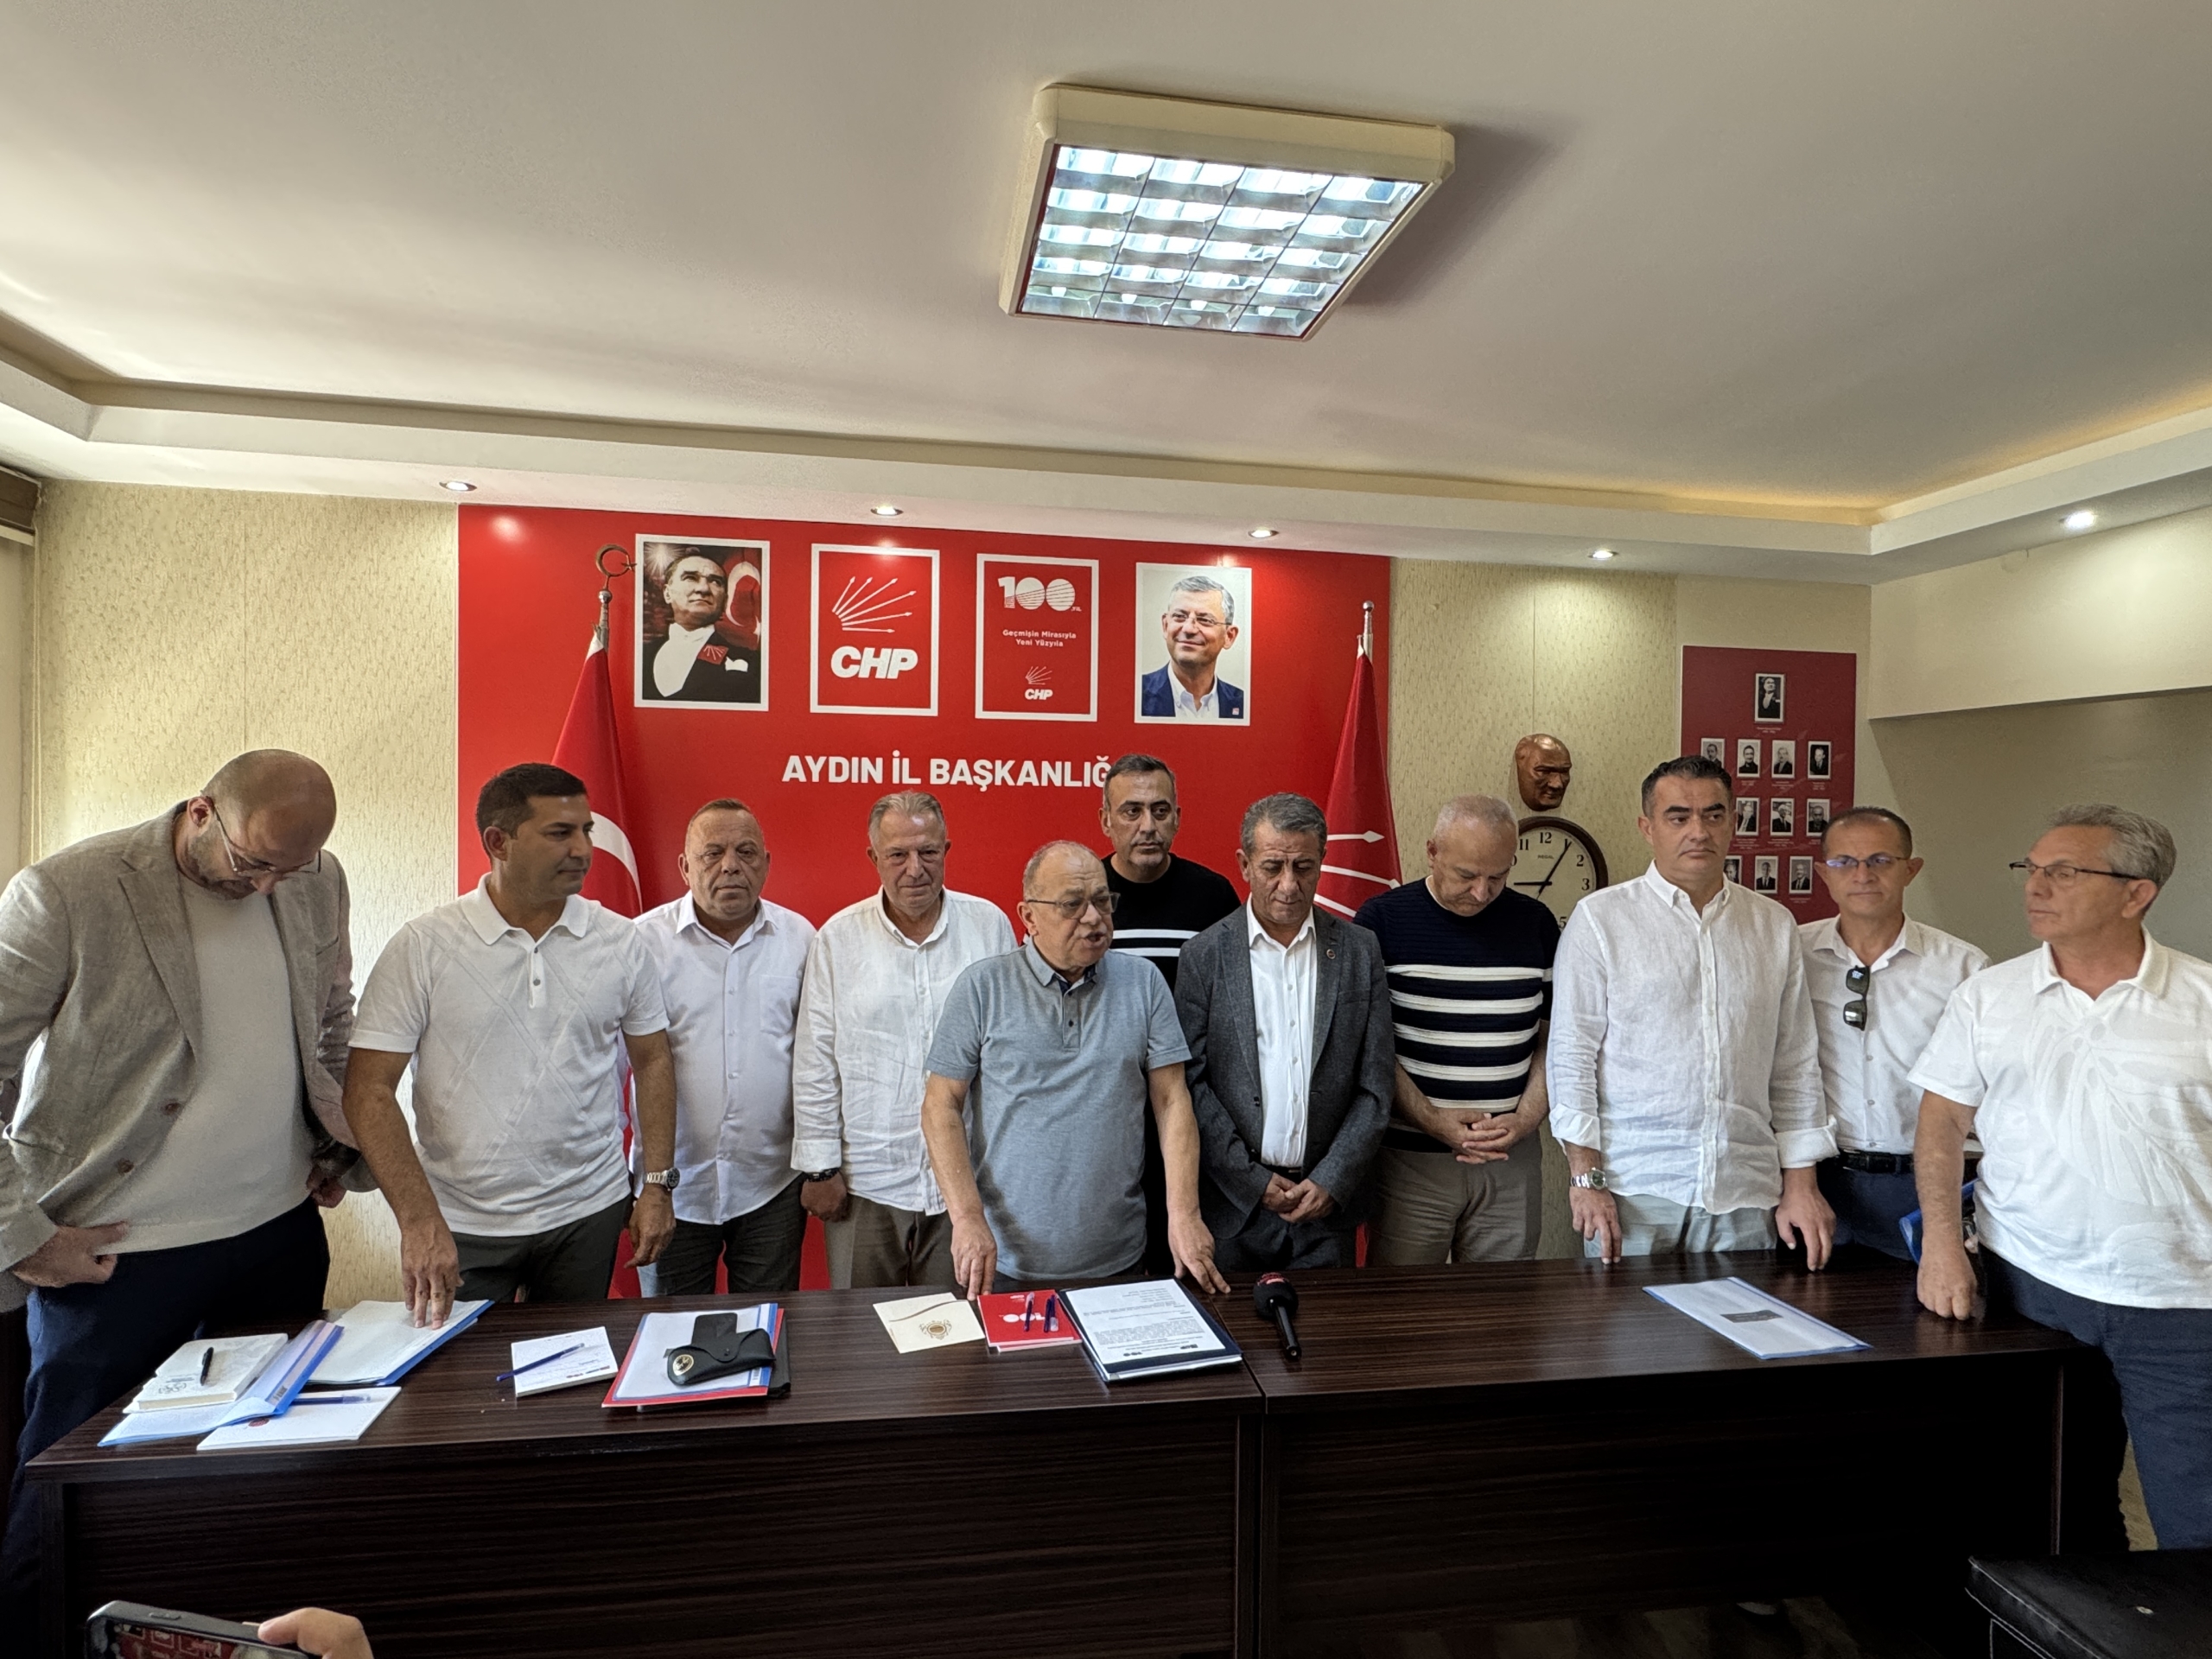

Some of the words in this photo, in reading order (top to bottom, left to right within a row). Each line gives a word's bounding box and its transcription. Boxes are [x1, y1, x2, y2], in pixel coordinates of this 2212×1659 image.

[998, 576, 1075, 611] 100
[1002, 629, 1039, 638] Geçmişin
[1041, 631, 1077, 639] Mirasıyla
[1035, 639, 1064, 648] Yüzyıla
[831, 645, 918, 679] CHP
[1025, 689, 1053, 700] CHP
[782, 755, 883, 784] AYDIN
[893, 750, 922, 784] İL
[930, 755, 1113, 791] BAŞKANLIĞ
[1540, 832, 1552, 844] 12
[1519, 839, 1529, 851] 11
[1576, 854, 1585, 867] 2
[1581, 878, 1590, 891] 3
[1559, 916, 1567, 929] 5
